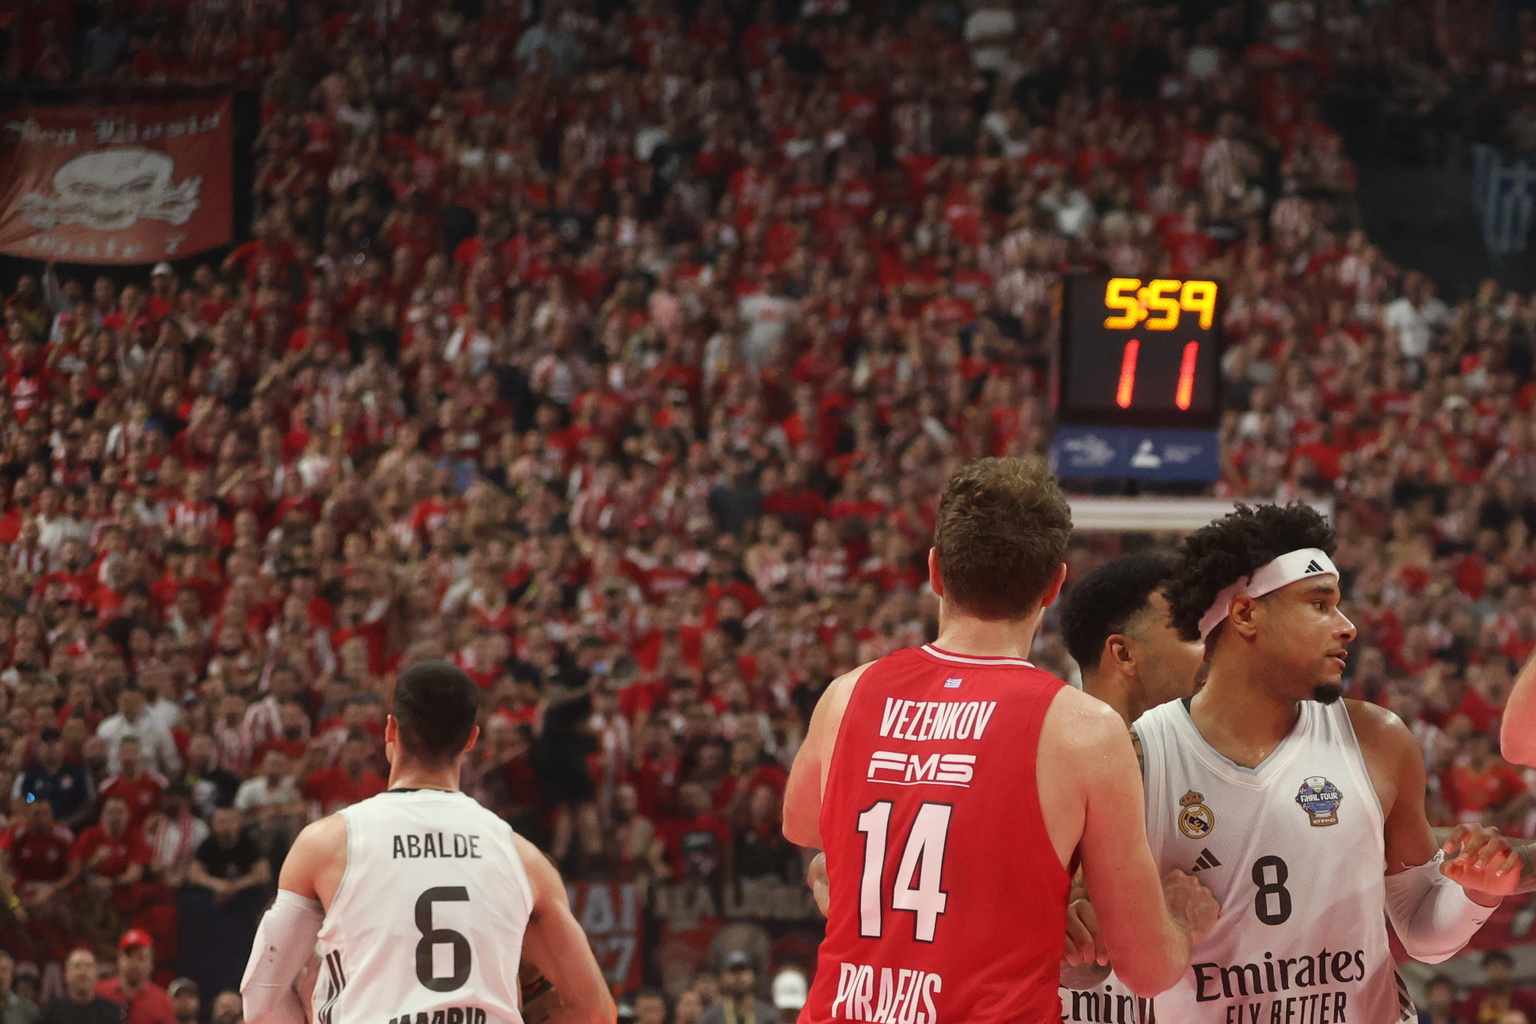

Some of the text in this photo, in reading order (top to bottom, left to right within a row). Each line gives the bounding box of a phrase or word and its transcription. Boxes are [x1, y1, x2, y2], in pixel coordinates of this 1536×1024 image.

[1103, 277, 1218, 331] 5:59
[1116, 339, 1199, 411] 11
[879, 697, 997, 741] VEZENKOV
[867, 751, 976, 783] FMS
[1300, 791, 1338, 803] FINAL FOUR
[392, 832, 482, 859] ABALDE
[857, 800, 953, 943] 14
[1251, 855, 1292, 926] 8
[414, 886, 472, 993] 6
[1192, 947, 1365, 1003] Emirates
